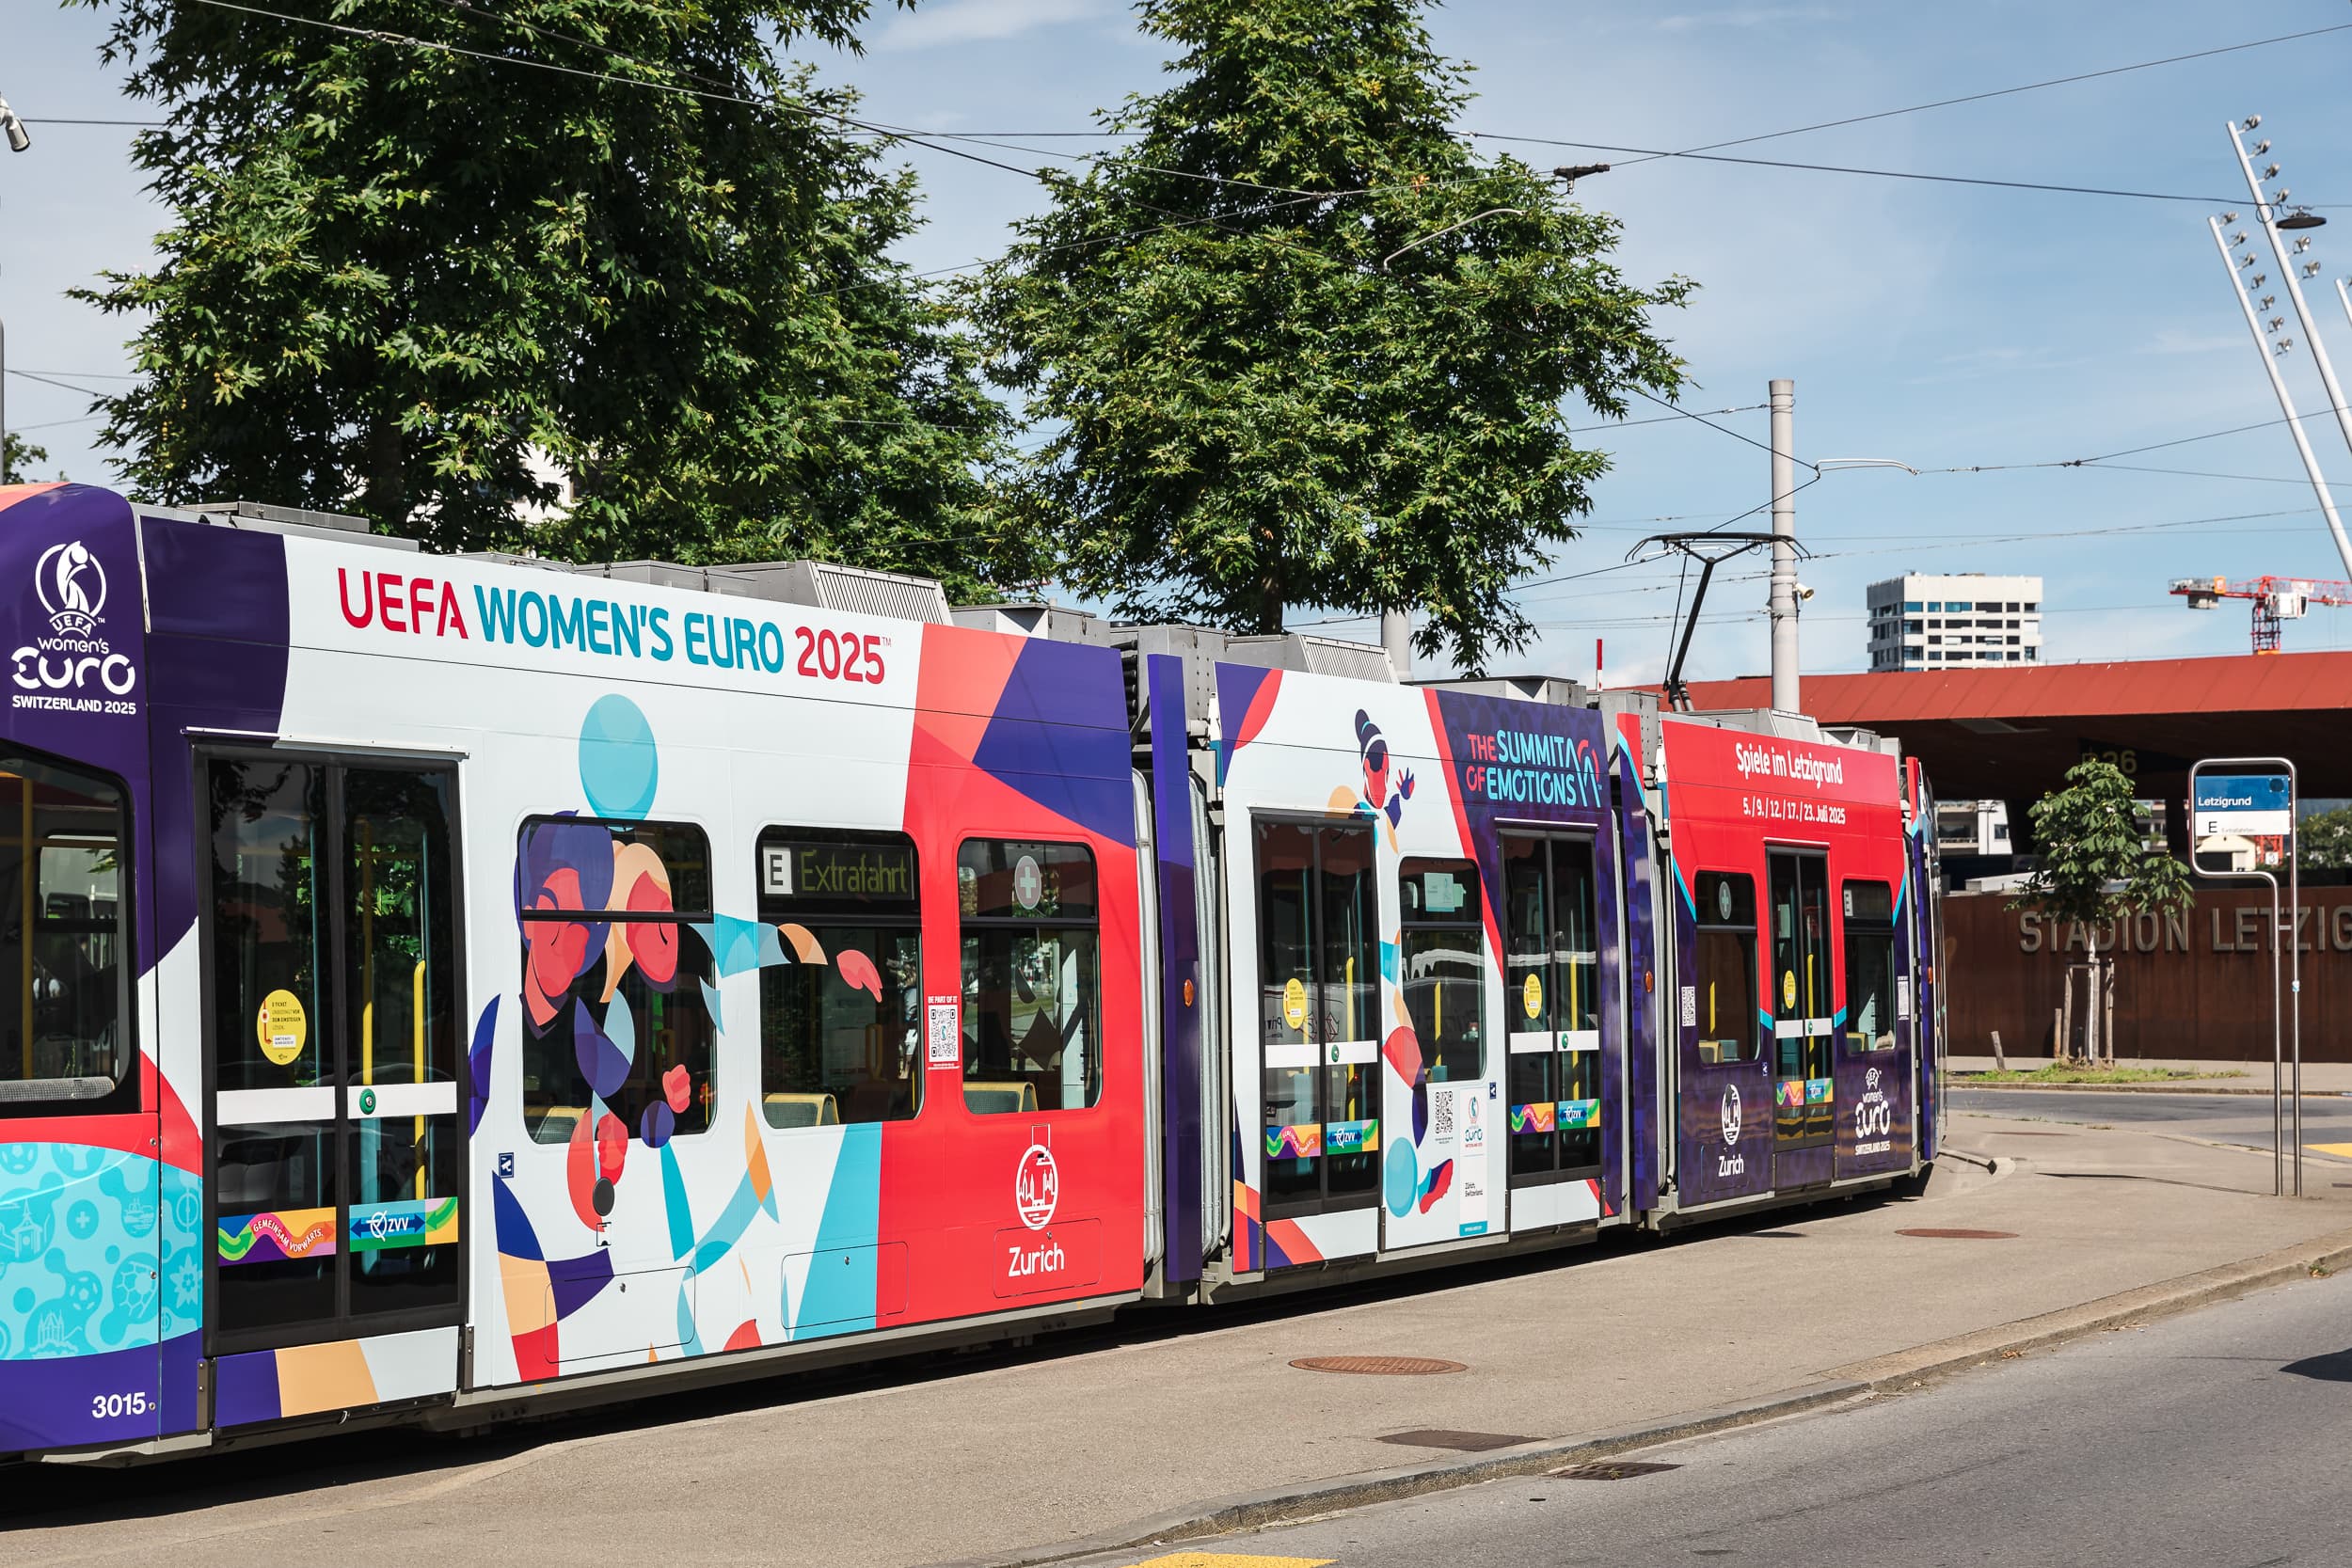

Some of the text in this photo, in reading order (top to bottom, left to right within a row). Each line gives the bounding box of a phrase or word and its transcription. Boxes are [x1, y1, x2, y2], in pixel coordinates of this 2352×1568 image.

[52, 614, 93, 636] UEFA
[338, 567, 469, 640] UEFA
[473, 584, 674, 661] WOMEN'S
[684, 612, 785, 674] EURO
[795, 626, 885, 685] 2025
[37, 636, 110, 655] women's
[12, 694, 136, 716] SWITZERLAND 2025
[1467, 734, 1498, 763] THE
[1735, 742, 1843, 790] Spiele im Letzigrund
[1466, 765, 1577, 807] OF EMOTIONS
[1828, 806, 1846, 825] 2025
[2198, 796, 2252, 809] Letzigrund
[2208, 821, 2217, 833] E
[770, 848, 908, 893] E Extrafahrt
[2020, 908, 2189, 952] STADION
[1718, 1153, 1744, 1178] Zurich
[253, 1218, 290, 1250] GEMEINSAM
[388, 1216, 409, 1233] ZVV
[1008, 1242, 1065, 1277] Zurich
[91, 1391, 146, 1418] 3015
